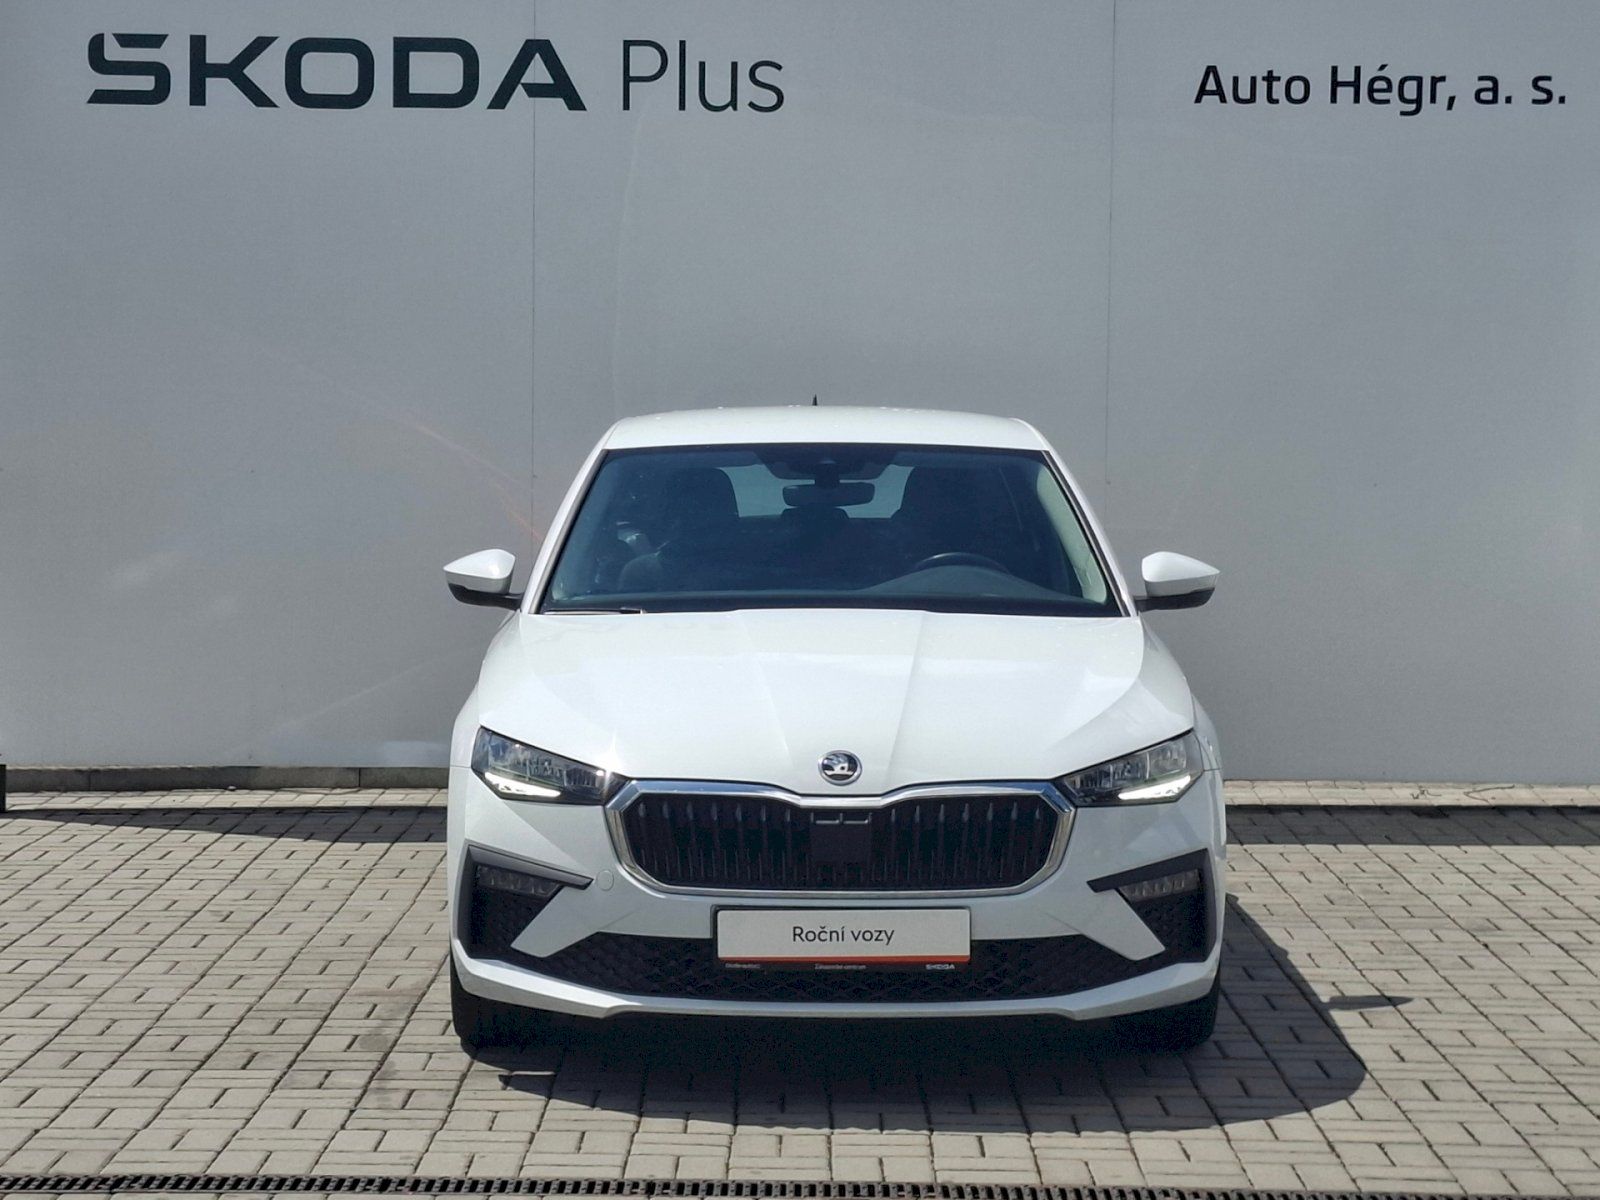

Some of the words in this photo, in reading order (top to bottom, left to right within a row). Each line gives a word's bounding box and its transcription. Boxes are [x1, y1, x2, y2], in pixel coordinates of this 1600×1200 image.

[622, 39, 786, 113] Plus
[1193, 64, 1312, 106] Auto
[1329, 63, 1457, 117] Hégr,
[1473, 74, 1513, 106] a.
[1530, 74, 1567, 106] s.
[792, 925, 846, 943] Roční
[850, 929, 895, 947] vozy
